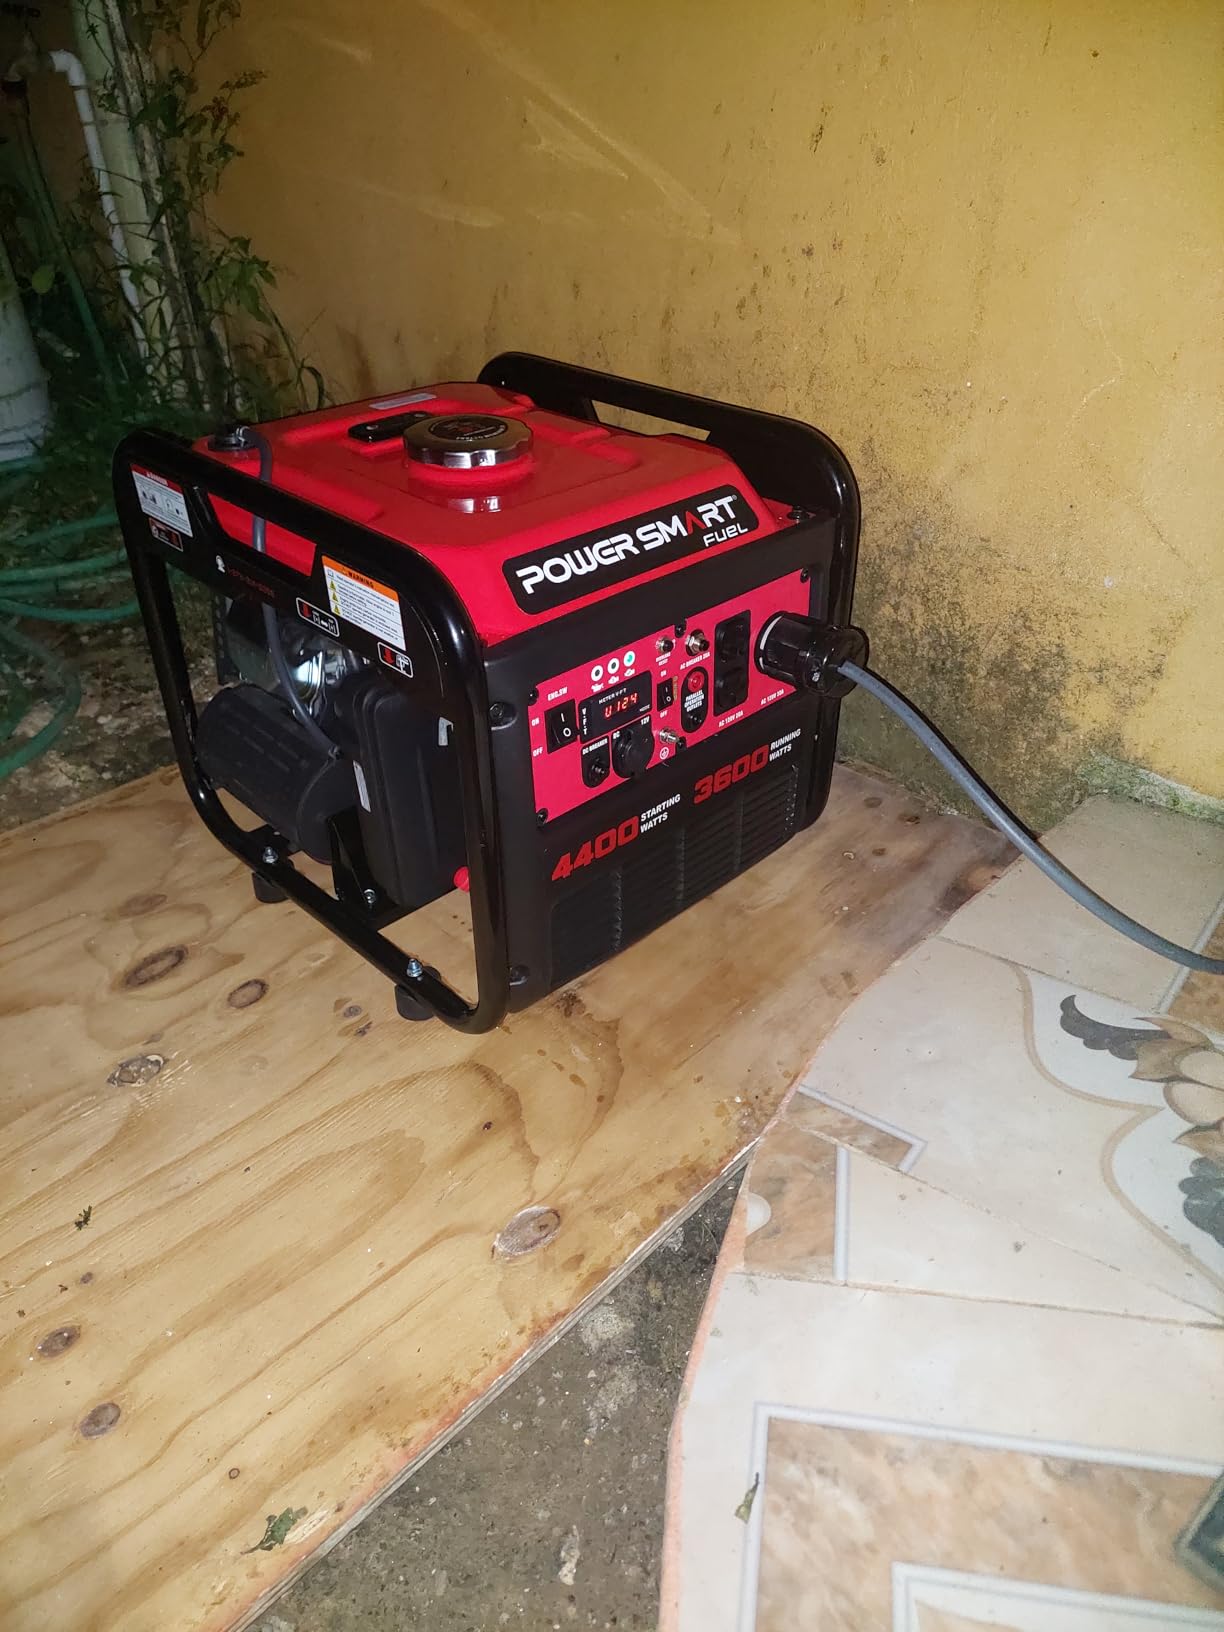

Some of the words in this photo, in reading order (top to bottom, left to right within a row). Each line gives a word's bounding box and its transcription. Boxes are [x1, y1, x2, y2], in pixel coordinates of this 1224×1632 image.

[515, 533, 640, 595] POWER
[635, 495, 738, 551] SMART
[598, 693, 615, 705] METER
[685, 689, 703, 702] PARALLEL
[531, 717, 540, 727] ON
[640, 715, 650, 725] 12V
[718, 719, 725, 728] AC
[725, 713, 736, 724] 120V
[589, 738, 608, 753] BREAKER
[770, 728, 801, 751] RUNNING
[532, 746, 543, 757] OFF
[693, 744, 770, 805] 3600
[769, 744, 792, 763] WATTS
[640, 793, 681, 822] STARTING
[551, 815, 640, 881] 4400
[640, 811, 668, 834] WATTS
